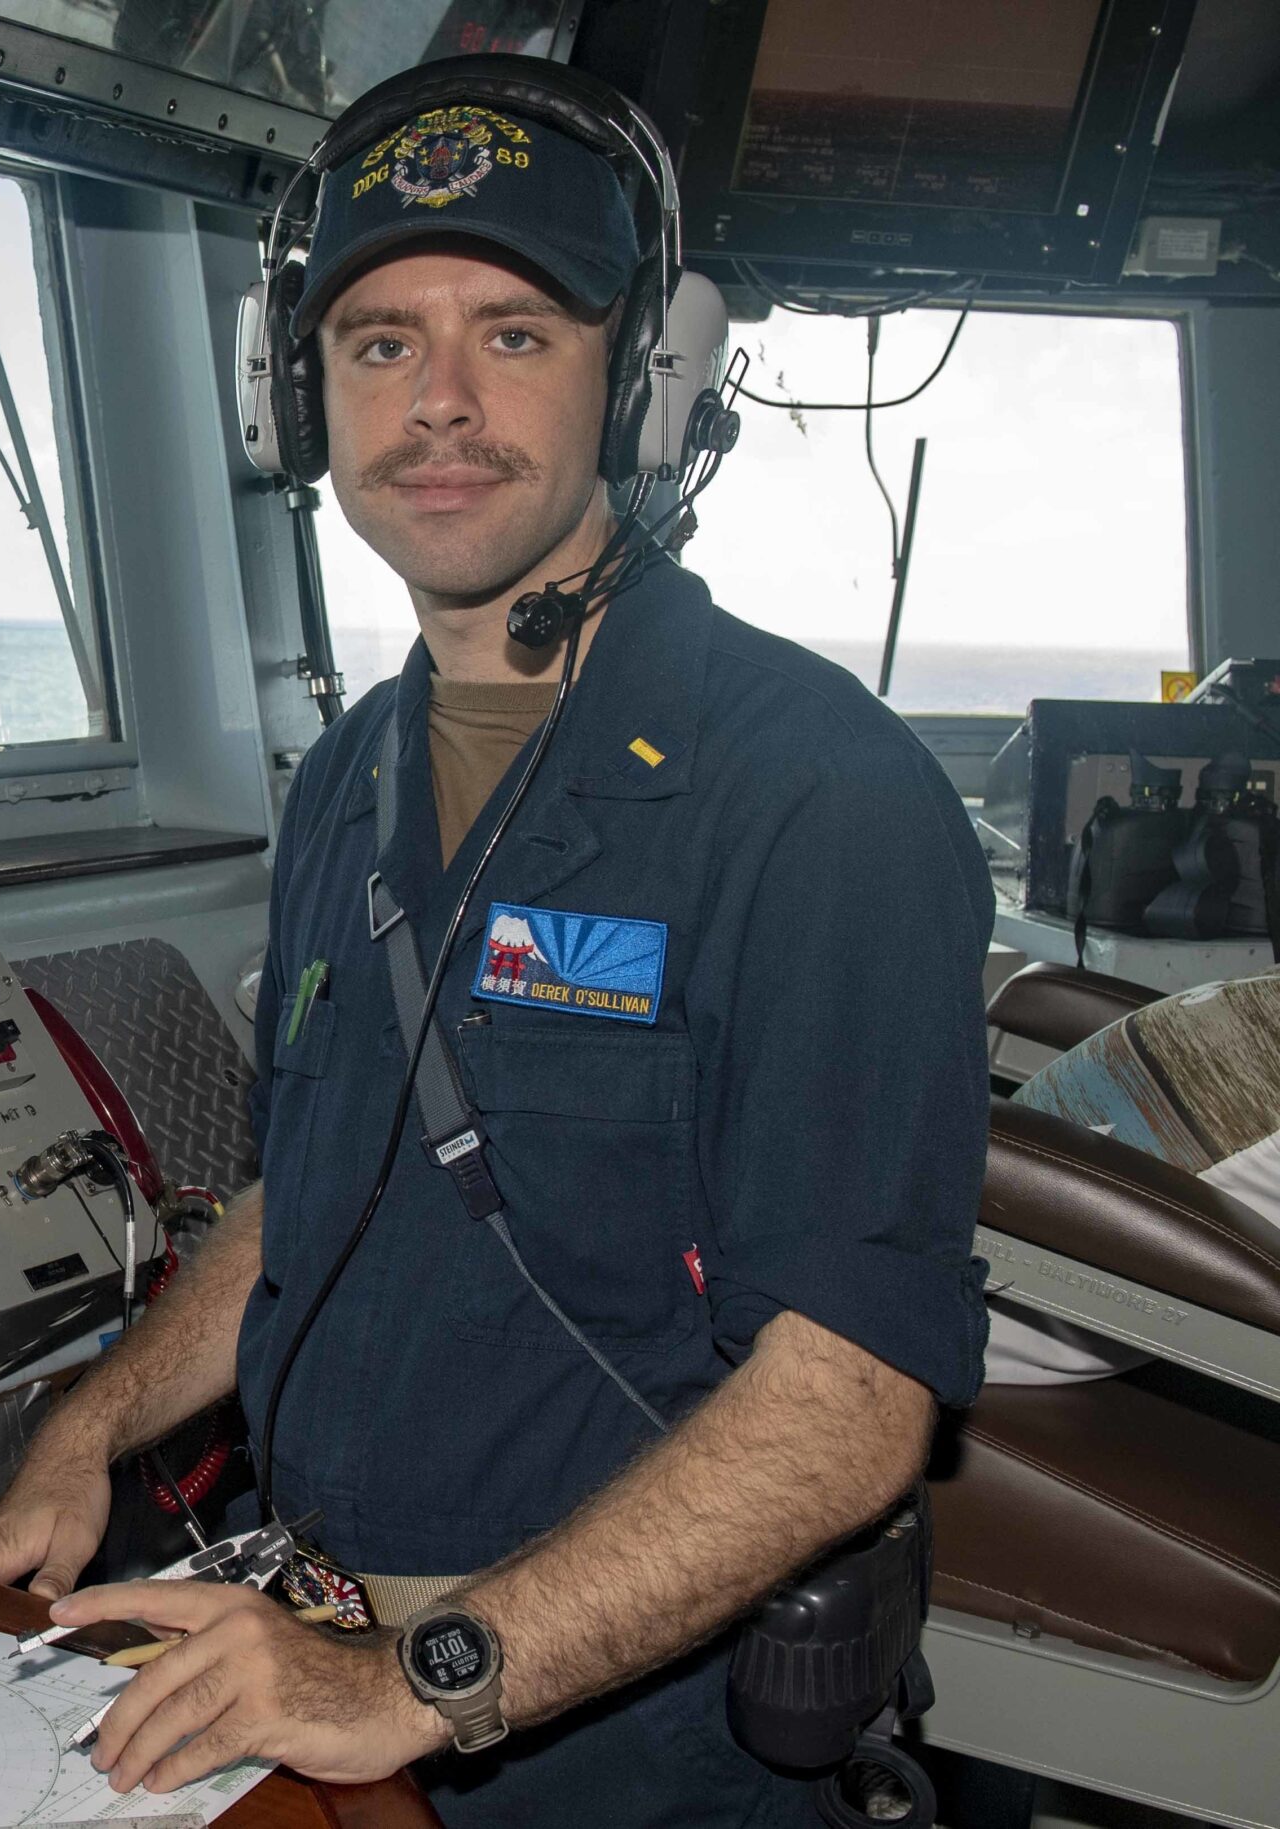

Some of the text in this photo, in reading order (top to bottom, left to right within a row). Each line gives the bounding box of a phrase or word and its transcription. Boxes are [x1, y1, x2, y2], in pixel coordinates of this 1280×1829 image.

[351, 147, 530, 199] DDG 89
[531, 982, 650, 1014] DEREK O'SULLIVAN
[439, 1138, 466, 1158] STEINER
[1038, 1259, 1158, 1315] BALTIMORE
[431, 1634, 469, 1664] 1017
[436, 1667, 447, 1677] 28
